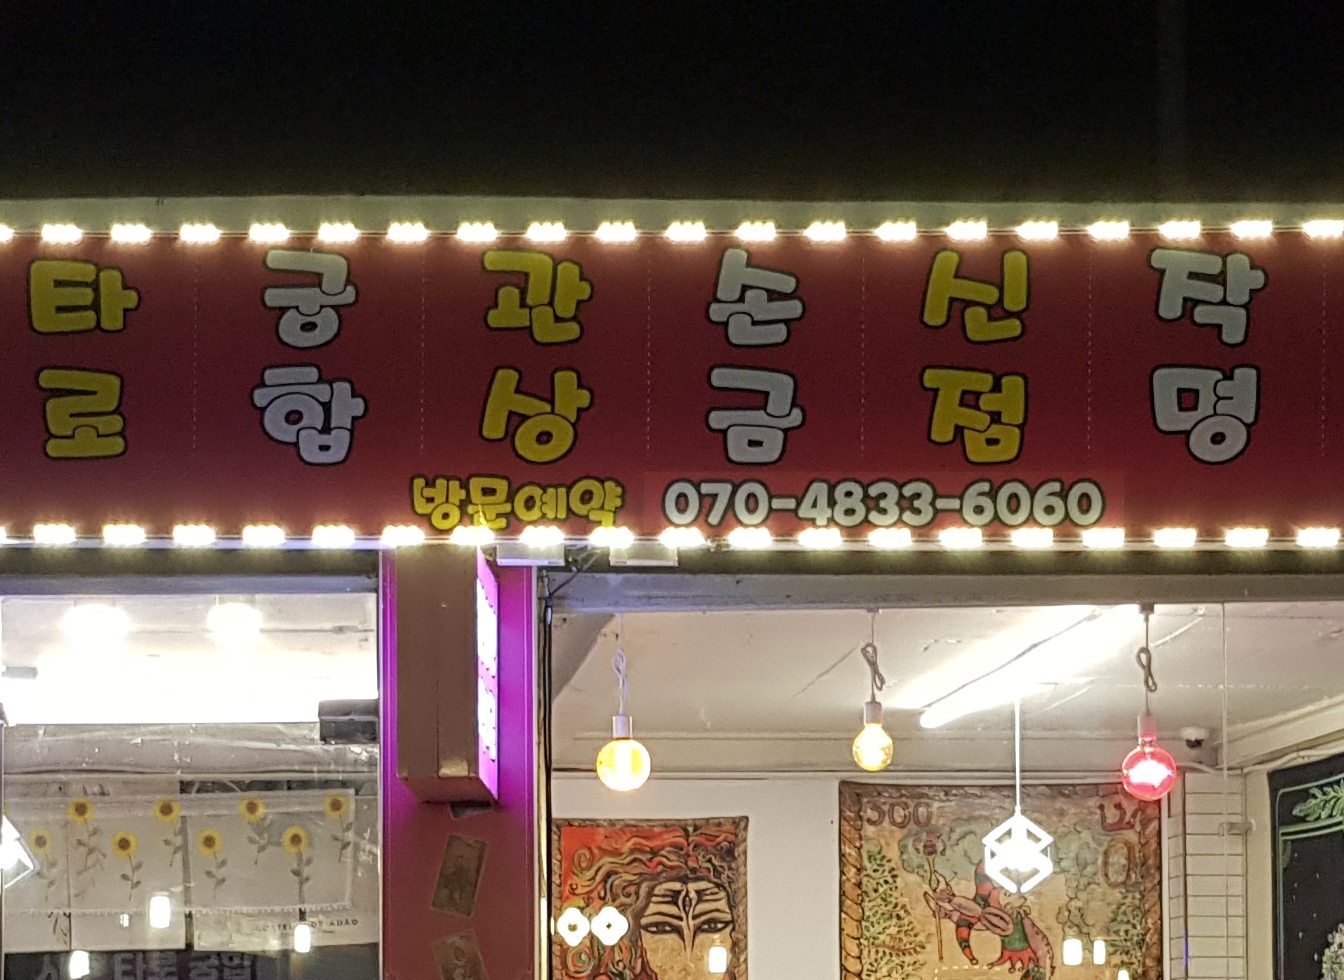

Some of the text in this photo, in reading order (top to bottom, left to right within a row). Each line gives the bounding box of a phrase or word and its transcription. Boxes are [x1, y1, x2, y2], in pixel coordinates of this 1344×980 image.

[28, 258, 140, 459] 타로
[252, 247, 366, 465] 궁합
[480, 247, 594, 464] 관상
[706, 246, 805, 464] 손금
[920, 247, 1029, 464] 신점
[1150, 246, 1267, 464] 작명
[411, 475, 1105, 530] 방문예약 070-4833-6060
